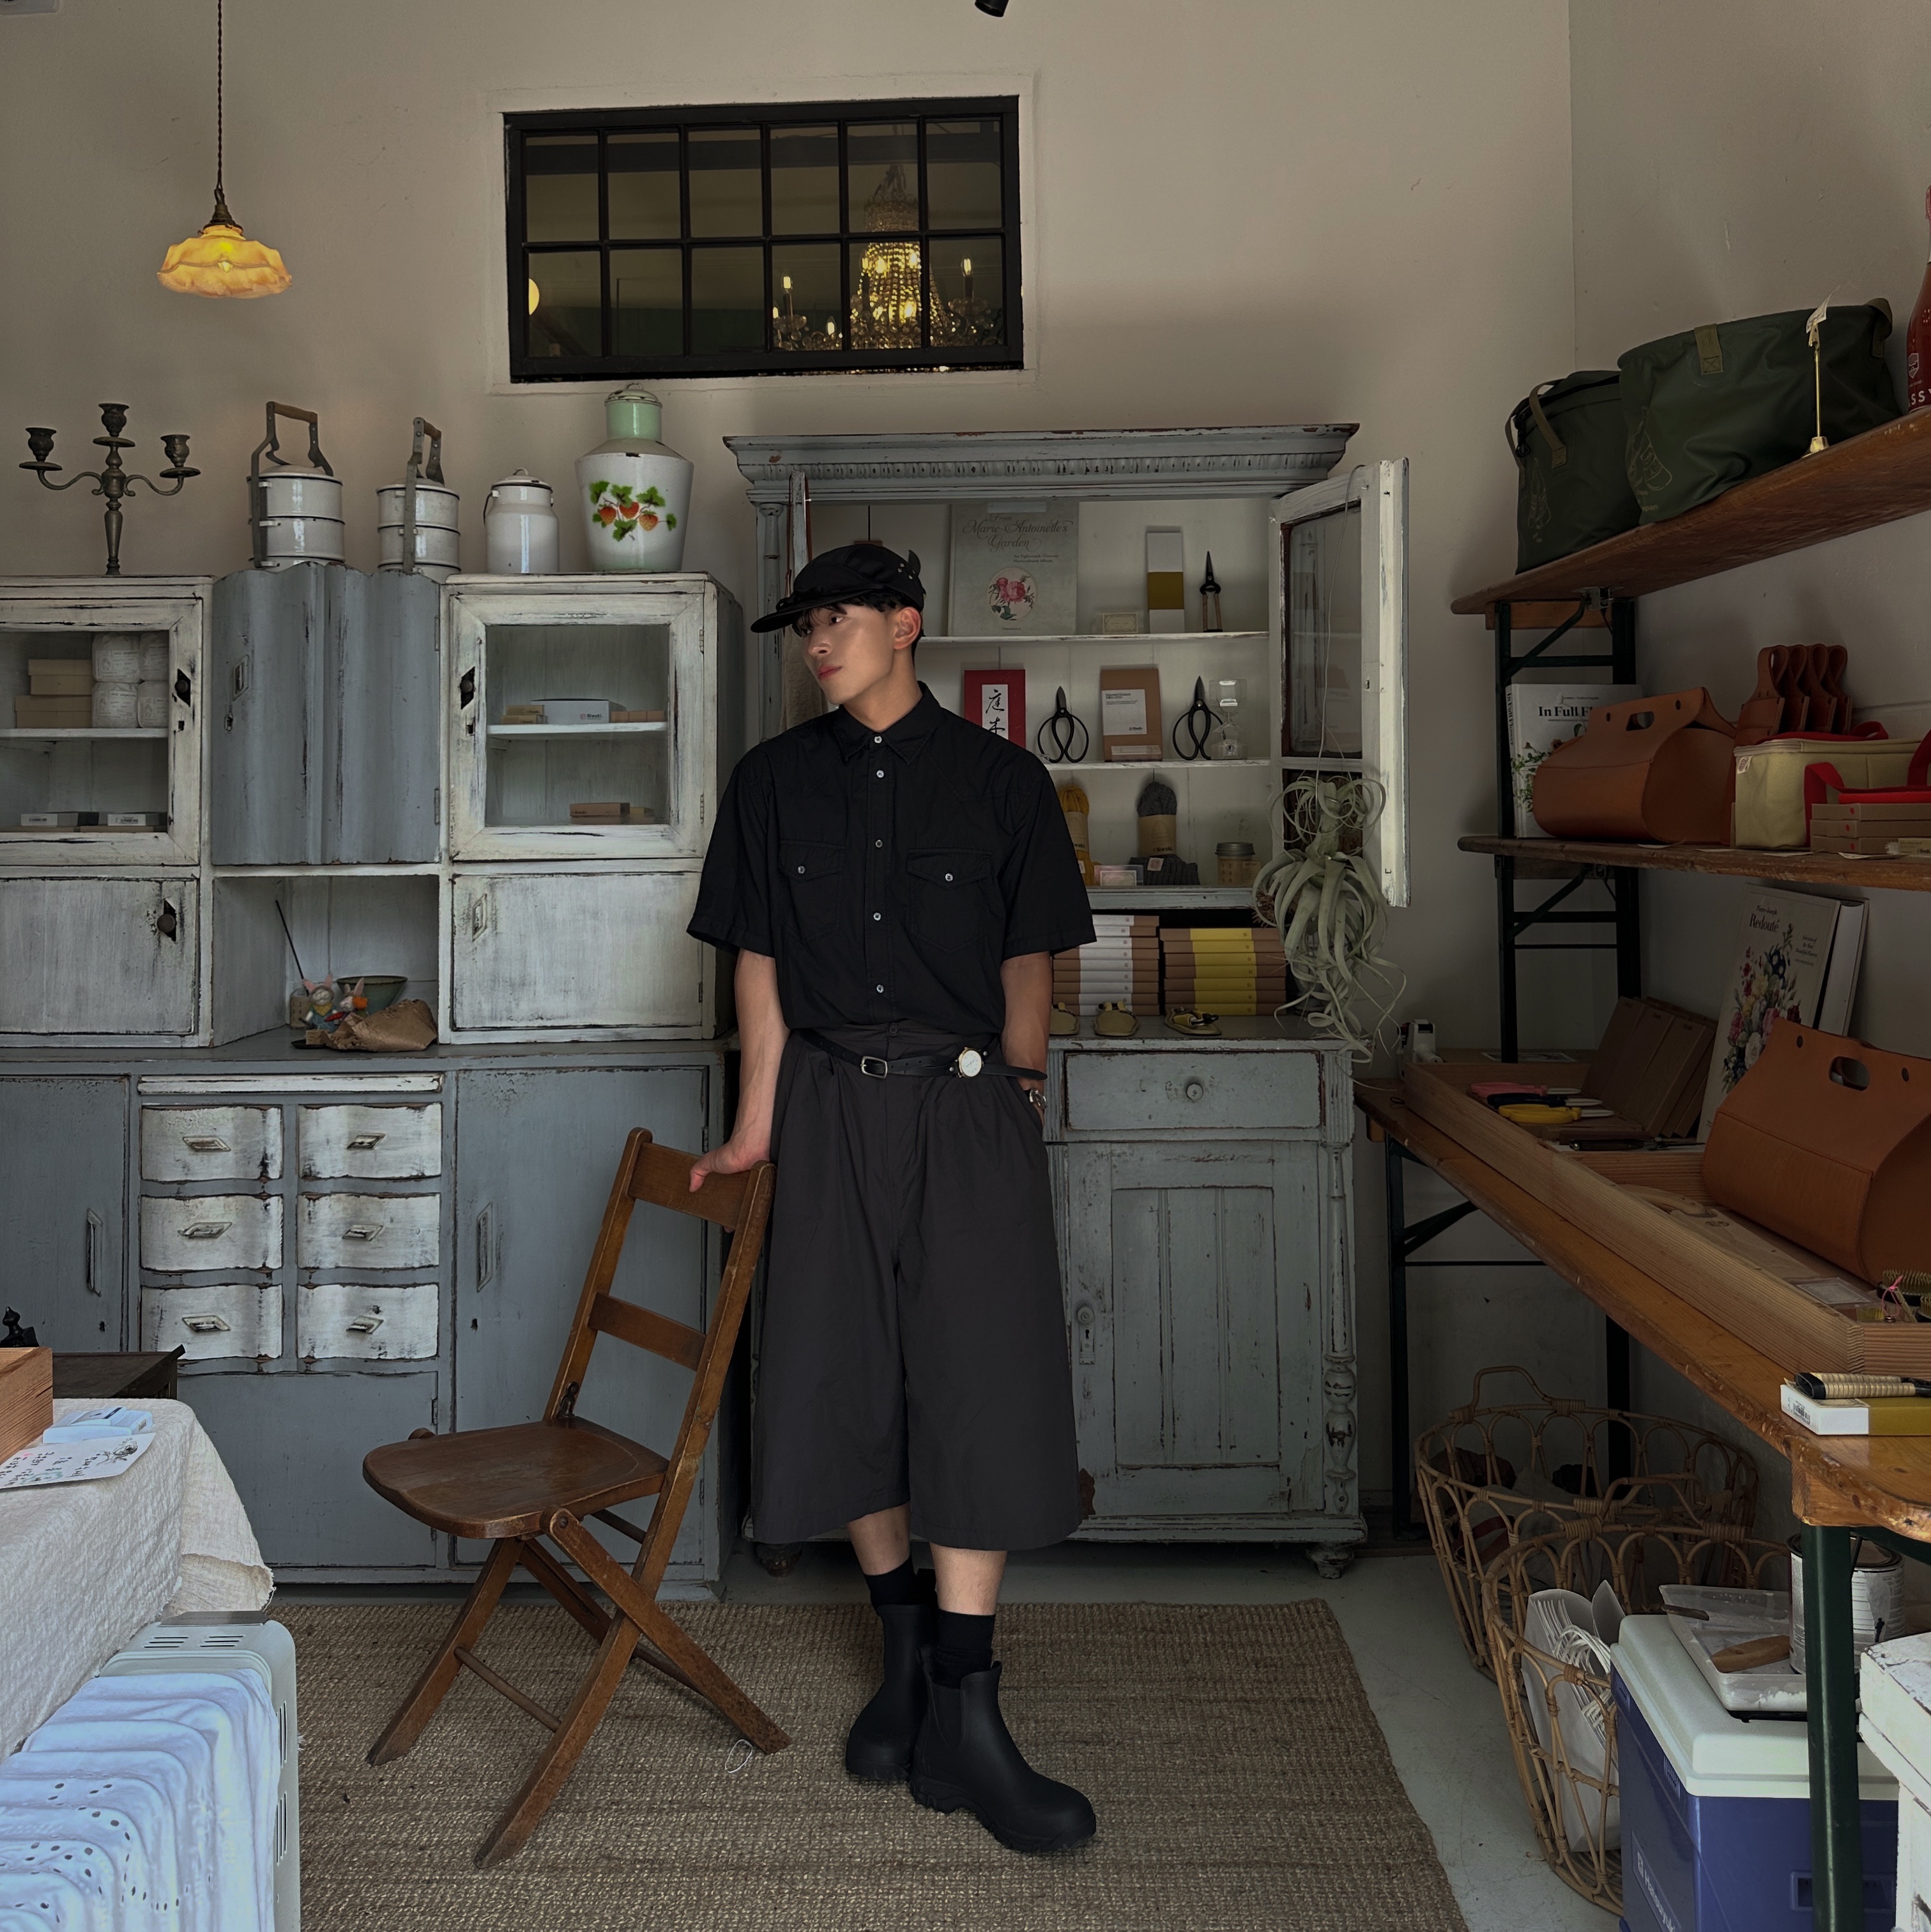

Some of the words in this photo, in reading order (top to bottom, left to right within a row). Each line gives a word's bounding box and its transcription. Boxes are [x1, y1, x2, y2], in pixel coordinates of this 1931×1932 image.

[962, 519, 1074, 540] Marie-Antoinette's
[988, 533, 1042, 552] Garden
[1538, 706, 1552, 717] In
[1553, 706, 1578, 717] Full
[1749, 913, 1780, 933] Redouté
